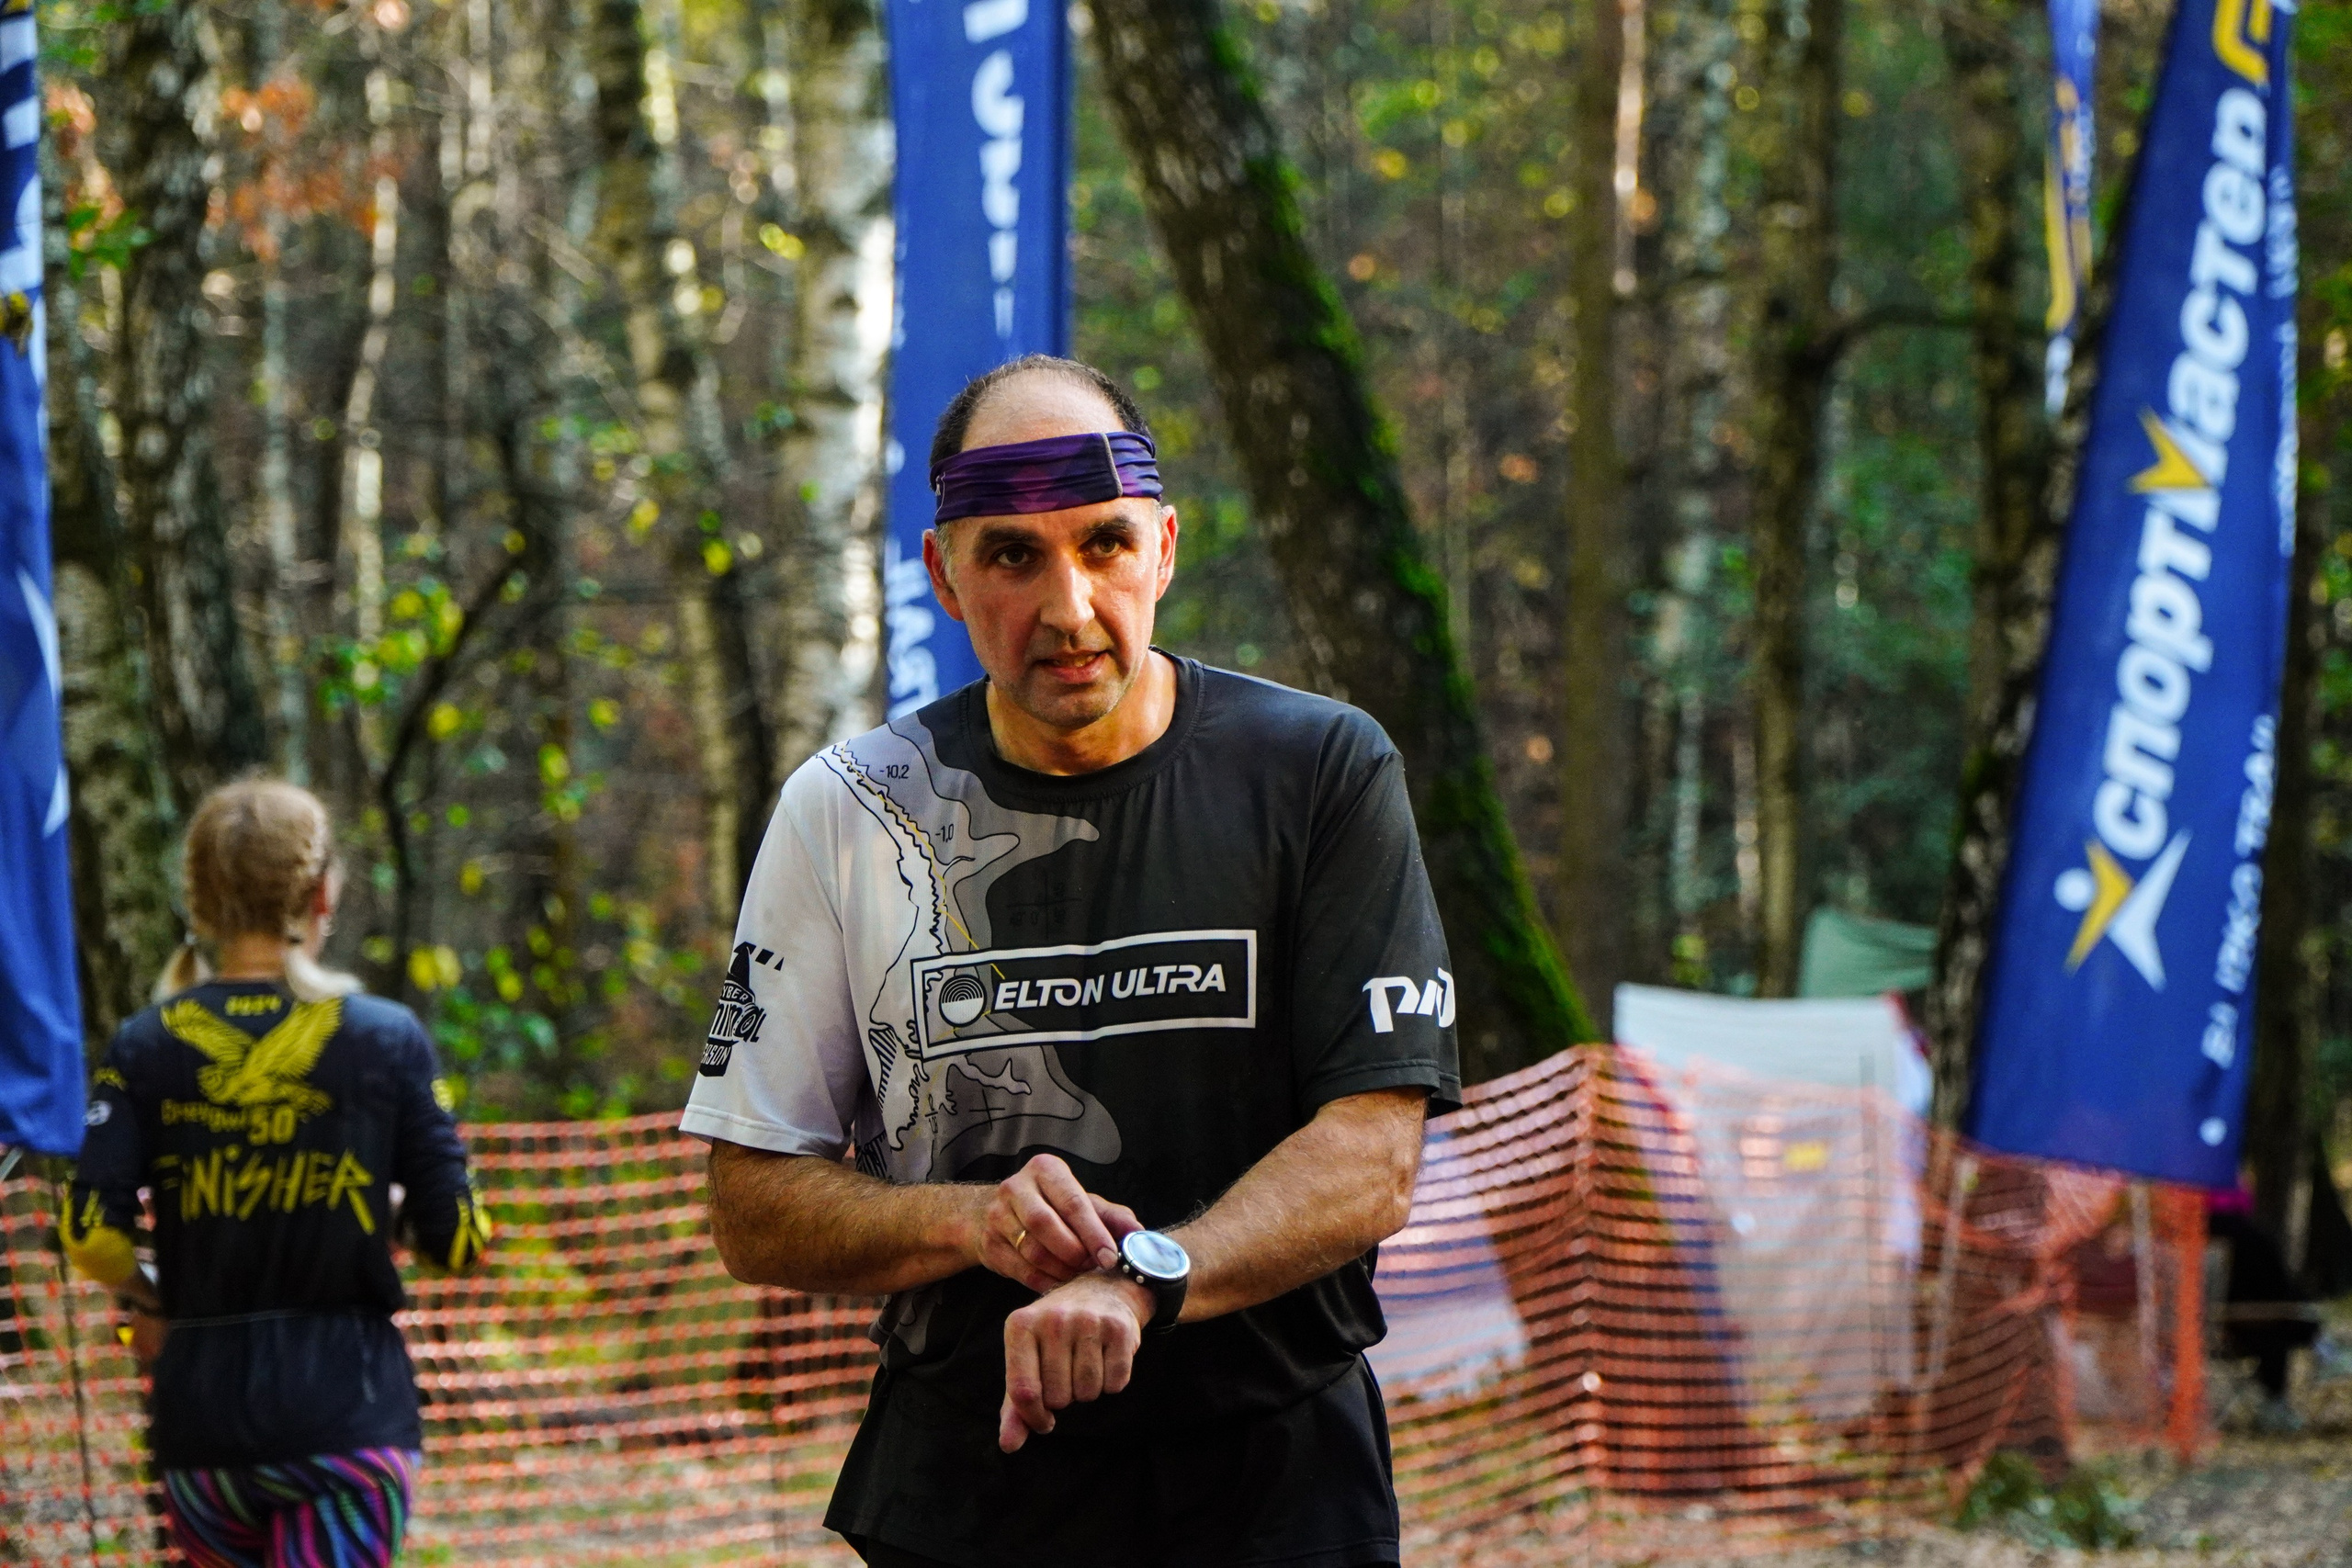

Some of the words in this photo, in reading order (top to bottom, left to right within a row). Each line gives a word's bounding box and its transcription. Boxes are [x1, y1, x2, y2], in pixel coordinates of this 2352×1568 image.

[721, 985, 749, 1002] YBER
[994, 975, 1105, 1010] ELTON
[1112, 964, 1227, 998] ULTRA
[247, 1105, 296, 1145] 50
